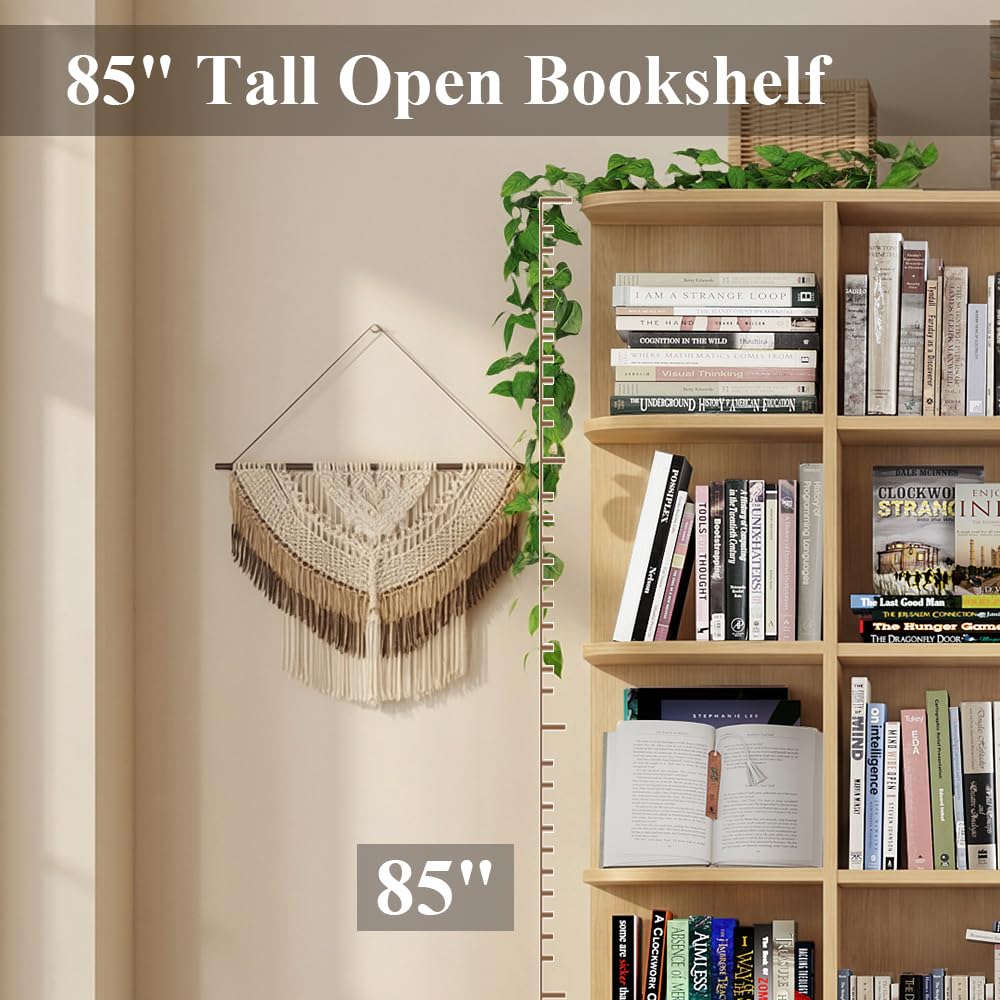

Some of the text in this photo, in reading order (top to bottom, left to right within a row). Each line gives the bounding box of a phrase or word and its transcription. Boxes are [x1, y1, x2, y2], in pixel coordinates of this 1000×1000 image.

[878, 487, 955, 499] CLOCKWO
[711, 518, 721, 580] Bootstrapping
[861, 598, 945, 606] The Last Good Man
[871, 634, 962, 642] THE DRAGONFLY DOOR
[903, 622, 957, 632] Hunger
[852, 716, 863, 761] MIND
[868, 707, 881, 795] on intelligence
[654, 915, 664, 923] A
[648, 927, 663, 989] CLOCKWORK
[671, 928, 685, 966] ABSENCE
[619, 960, 628, 986] sicker
[691, 931, 709, 991] AIMLESS
[671, 970, 686, 980] of
